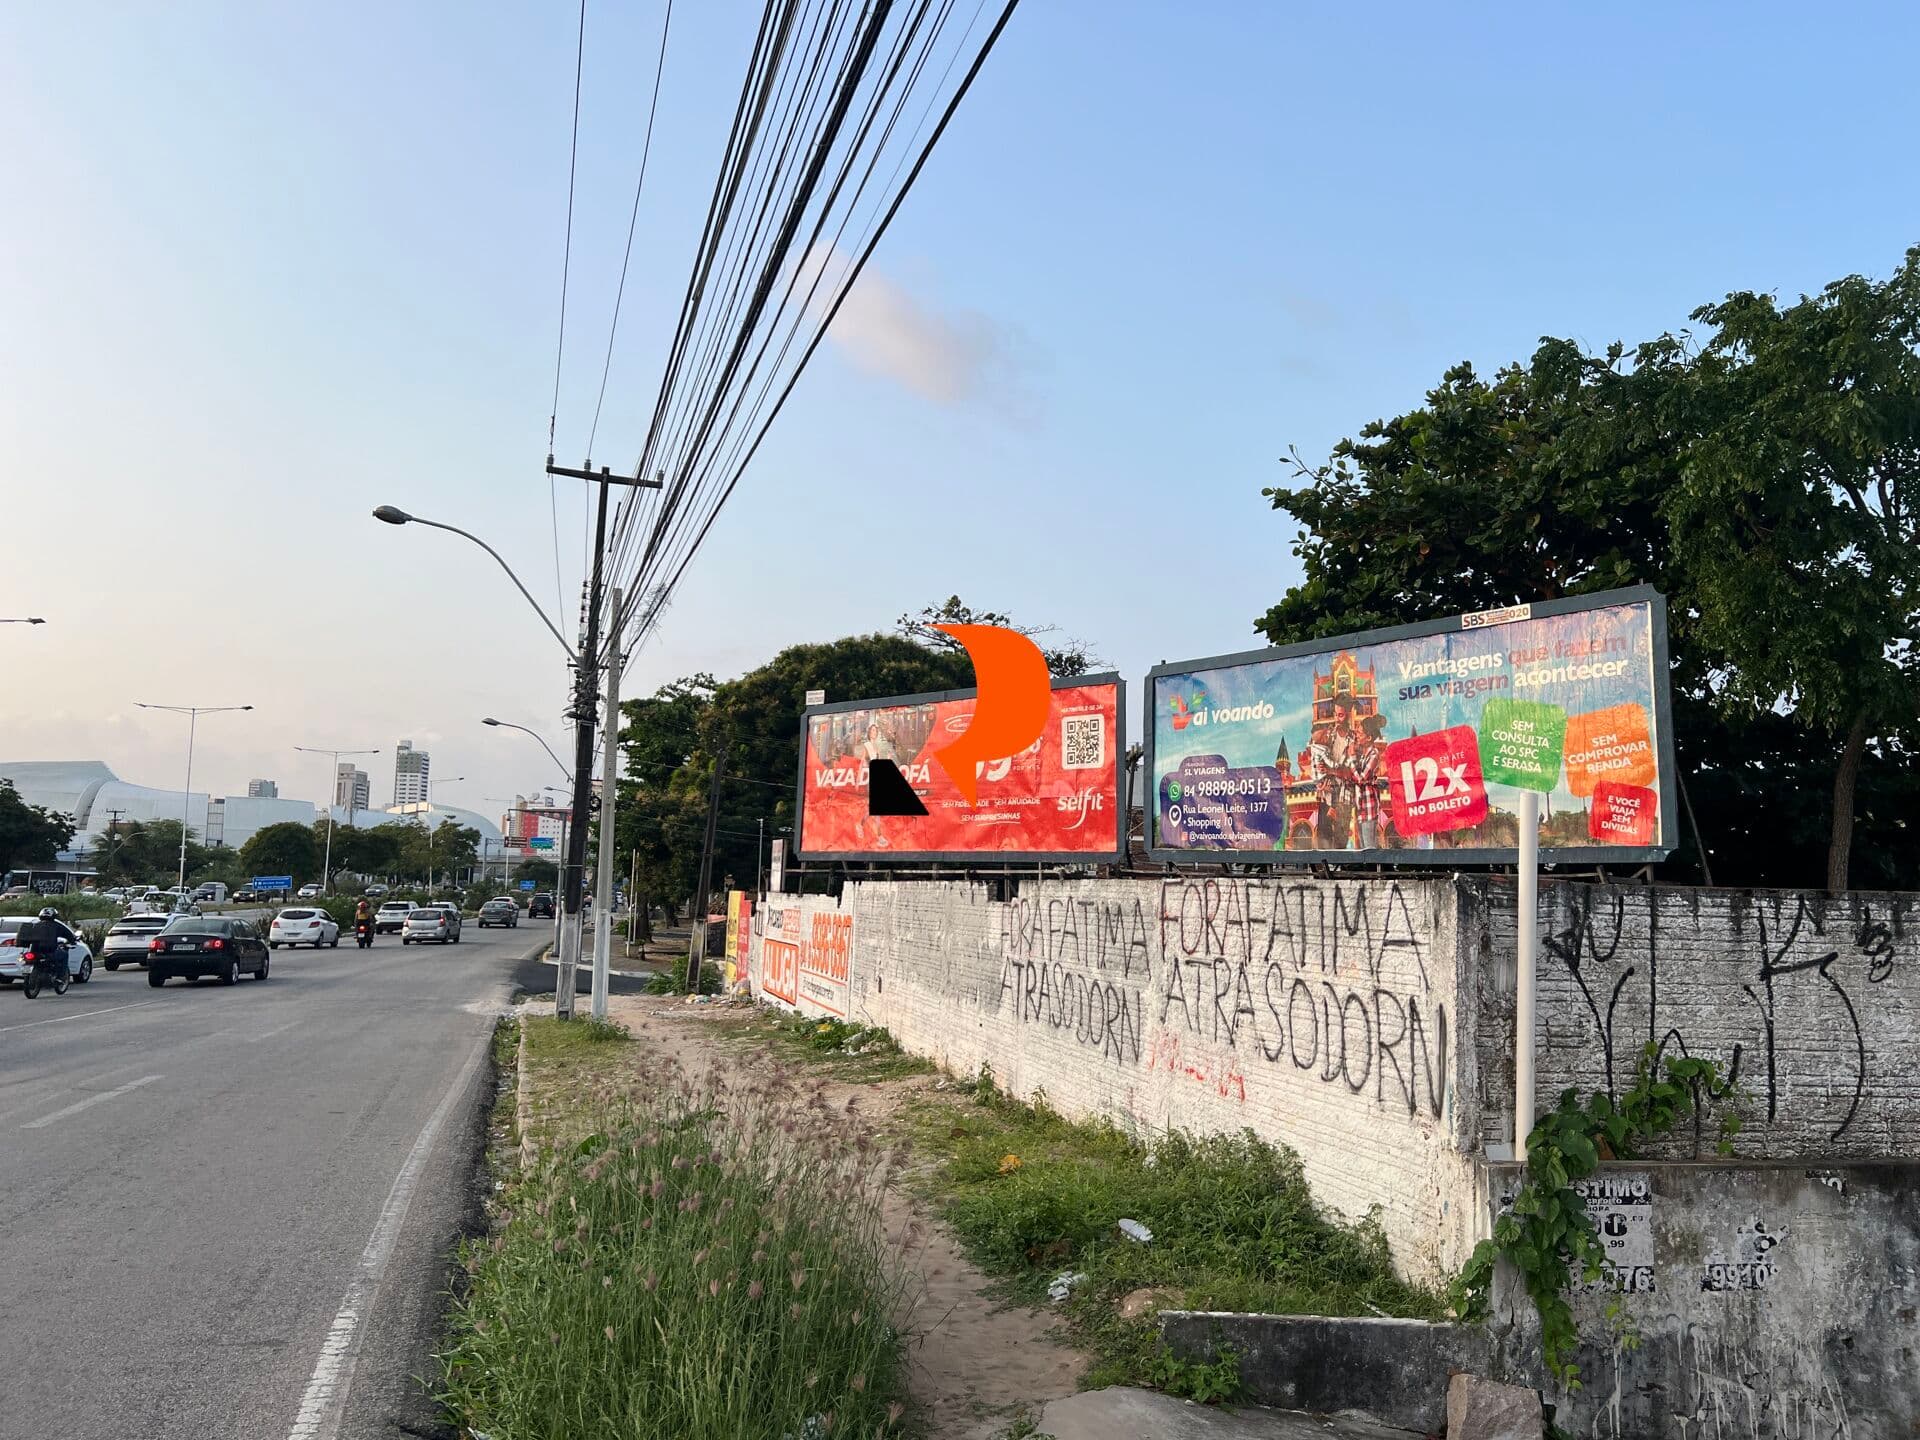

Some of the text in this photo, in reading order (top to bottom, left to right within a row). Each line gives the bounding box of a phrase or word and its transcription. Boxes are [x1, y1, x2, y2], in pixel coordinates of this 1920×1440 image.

[1463, 613, 1485, 627] SBS
[1398, 652, 1504, 680] Vantagens
[1508, 645, 1548, 668] que
[1398, 659, 1628, 700] sua viagem acontecer
[1211, 700, 1274, 724] voando
[1512, 720, 1534, 732] SEM
[1491, 730, 1550, 749] CONSULTA
[1592, 733, 1618, 748] SEM
[1500, 746, 1539, 760] AO SPC
[1568, 740, 1648, 765] COMPROVAR
[815, 767, 857, 788] VAZA
[898, 758, 931, 784] OFÁ
[1184, 766, 1226, 776] SL VIAGENS
[1493, 756, 1542, 774] E SERASA
[1587, 756, 1632, 775] RENDA
[1184, 778, 1271, 798] 84 98898-0513
[1400, 757, 1472, 805] 12x
[1057, 784, 1104, 830] selfit
[1183, 801, 1268, 815] Rua Leonel Leite, 1377
[1408, 796, 1471, 817] NO BOLETO
[1608, 795, 1641, 809] E VOCÊ
[1610, 804, 1637, 817] VIAJA
[1187, 816, 1233, 829] Shopping 10
[1611, 814, 1631, 825] SEM
[765, 944, 797, 1002] ALUGA
[1574, 1179, 1647, 1197] STIMO
